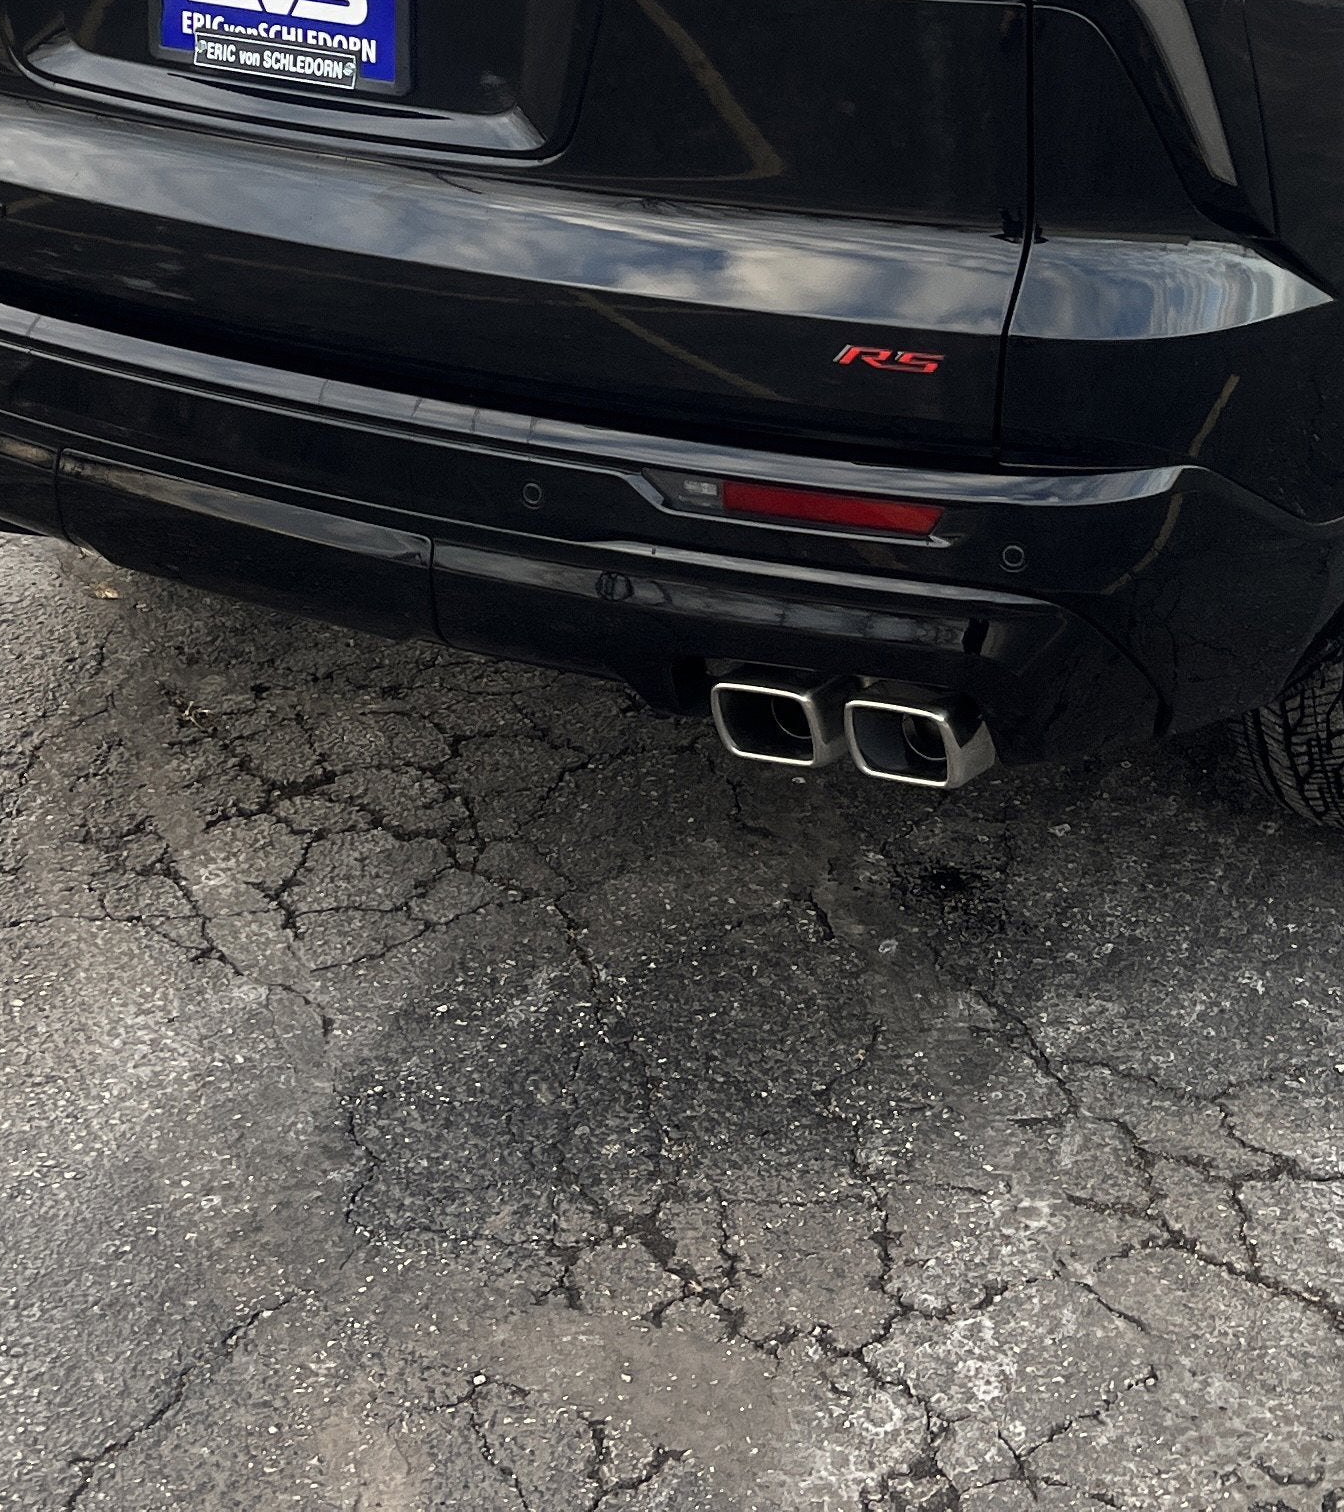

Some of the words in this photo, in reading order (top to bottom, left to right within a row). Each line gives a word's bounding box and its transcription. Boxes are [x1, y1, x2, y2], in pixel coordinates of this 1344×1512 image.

[207, 40, 236, 62] ERIC
[239, 50, 261, 67] von
[263, 50, 343, 80] SCHLEDORN
[833, 344, 945, 373] RS
